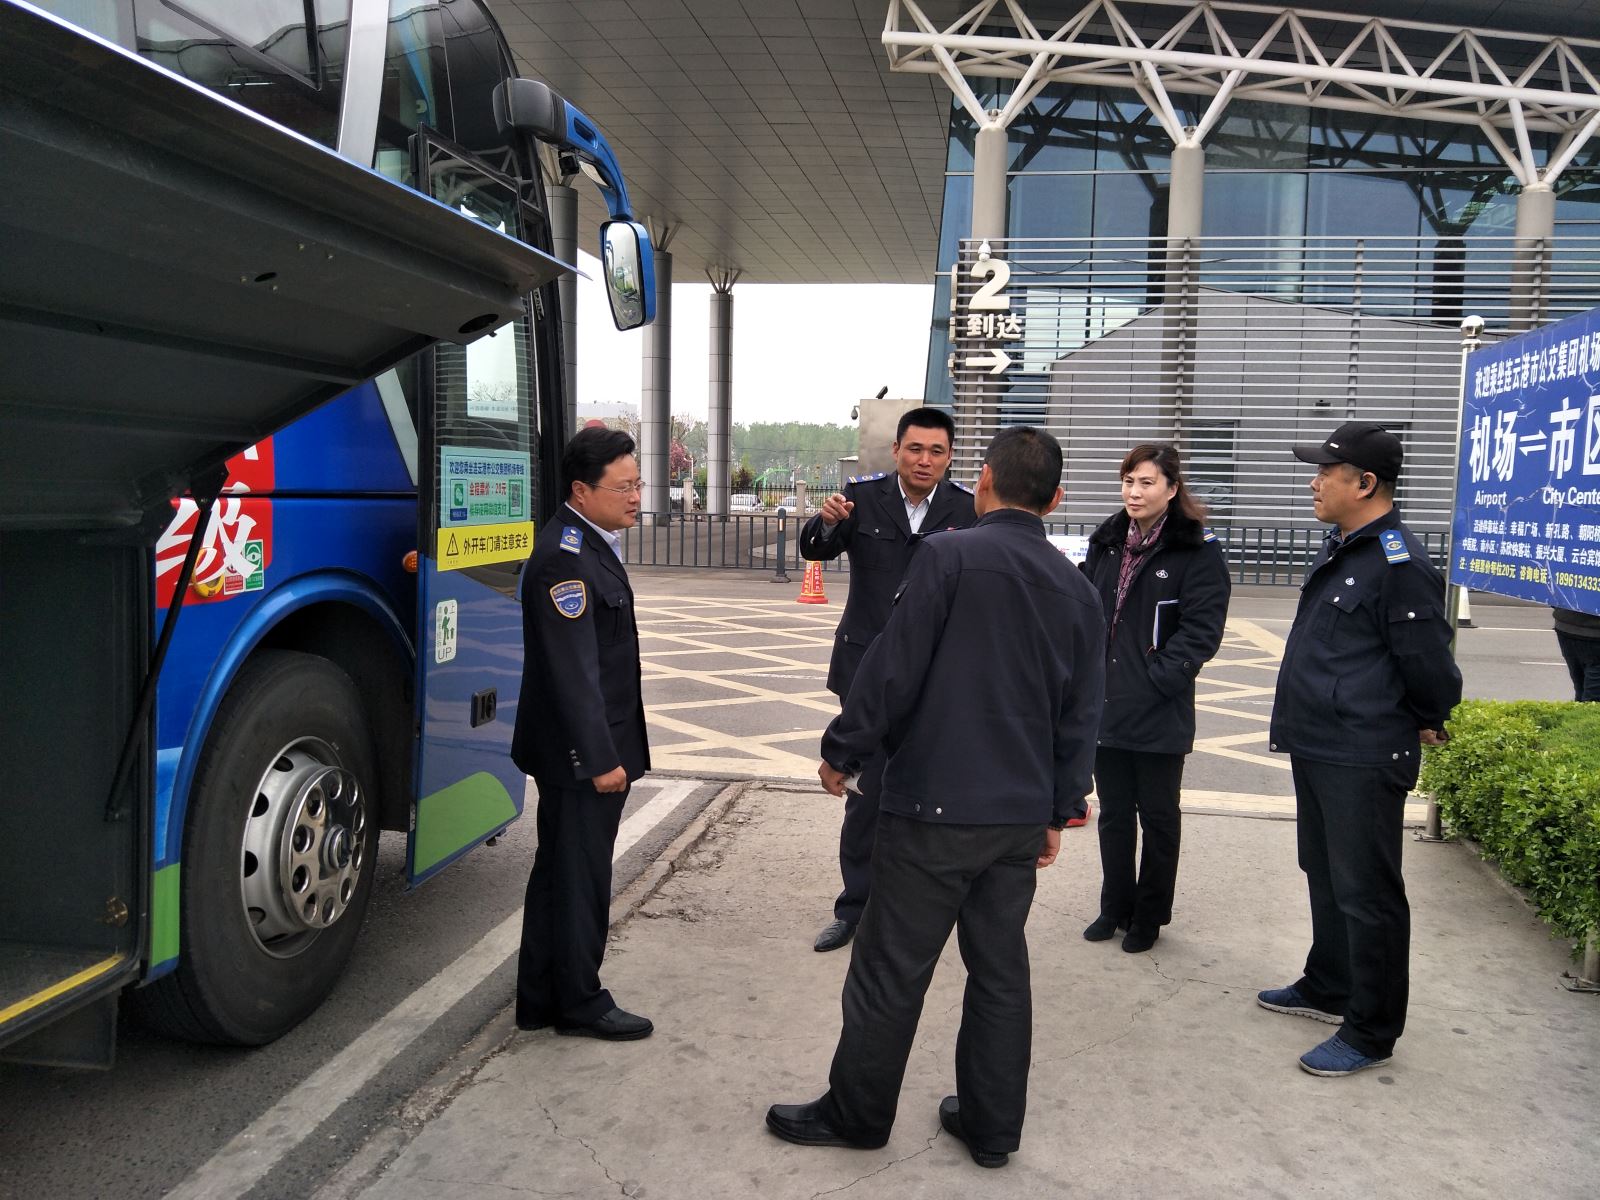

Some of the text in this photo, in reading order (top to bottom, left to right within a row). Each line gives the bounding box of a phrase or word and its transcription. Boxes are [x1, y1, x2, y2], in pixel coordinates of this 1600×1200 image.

[969, 259, 1010, 309] 2
[967, 313, 1021, 339] 到达
[1474, 490, 1507, 508] Airport
[1542, 487, 1565, 508] City
[463, 532, 528, 555] 外开车门请注意安全
[438, 647, 452, 660] UP
